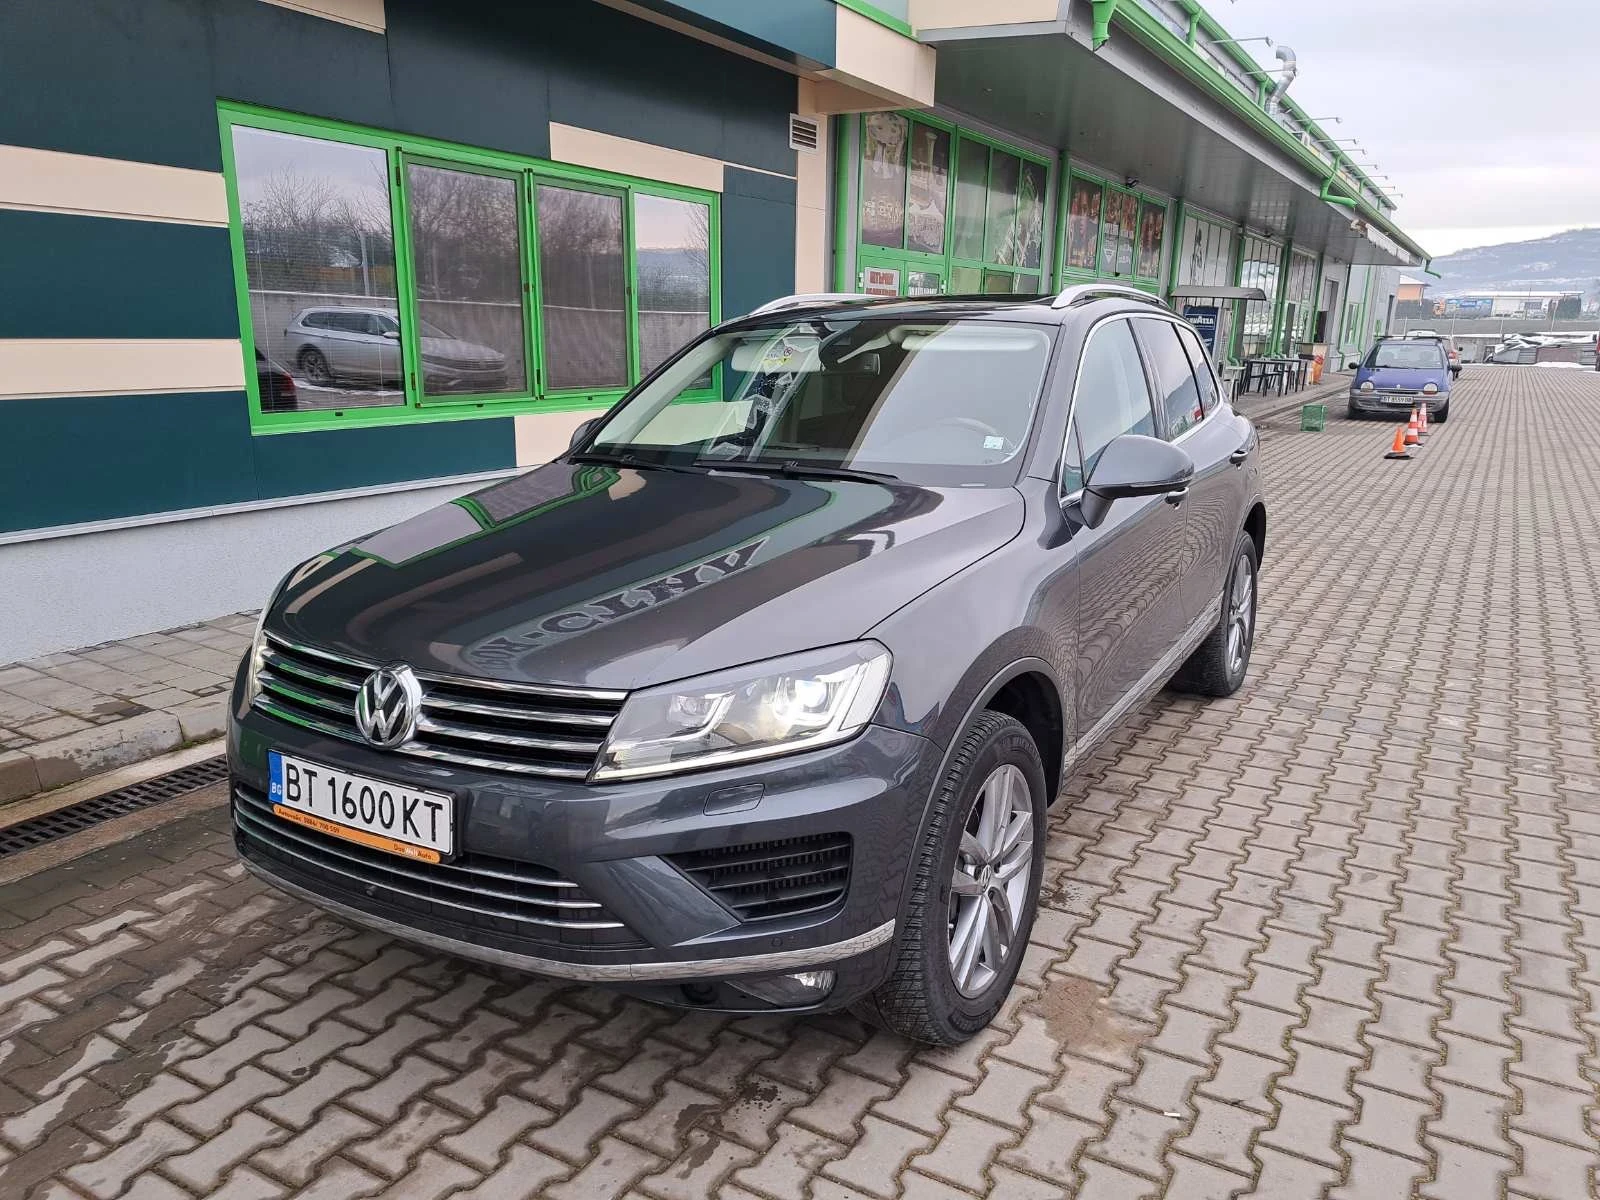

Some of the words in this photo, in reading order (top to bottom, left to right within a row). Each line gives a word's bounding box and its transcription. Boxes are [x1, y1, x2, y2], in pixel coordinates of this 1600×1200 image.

[271, 782, 282, 796] BG
[286, 763, 317, 807] BT
[328, 777, 395, 829] 1600
[402, 795, 443, 842] KT
